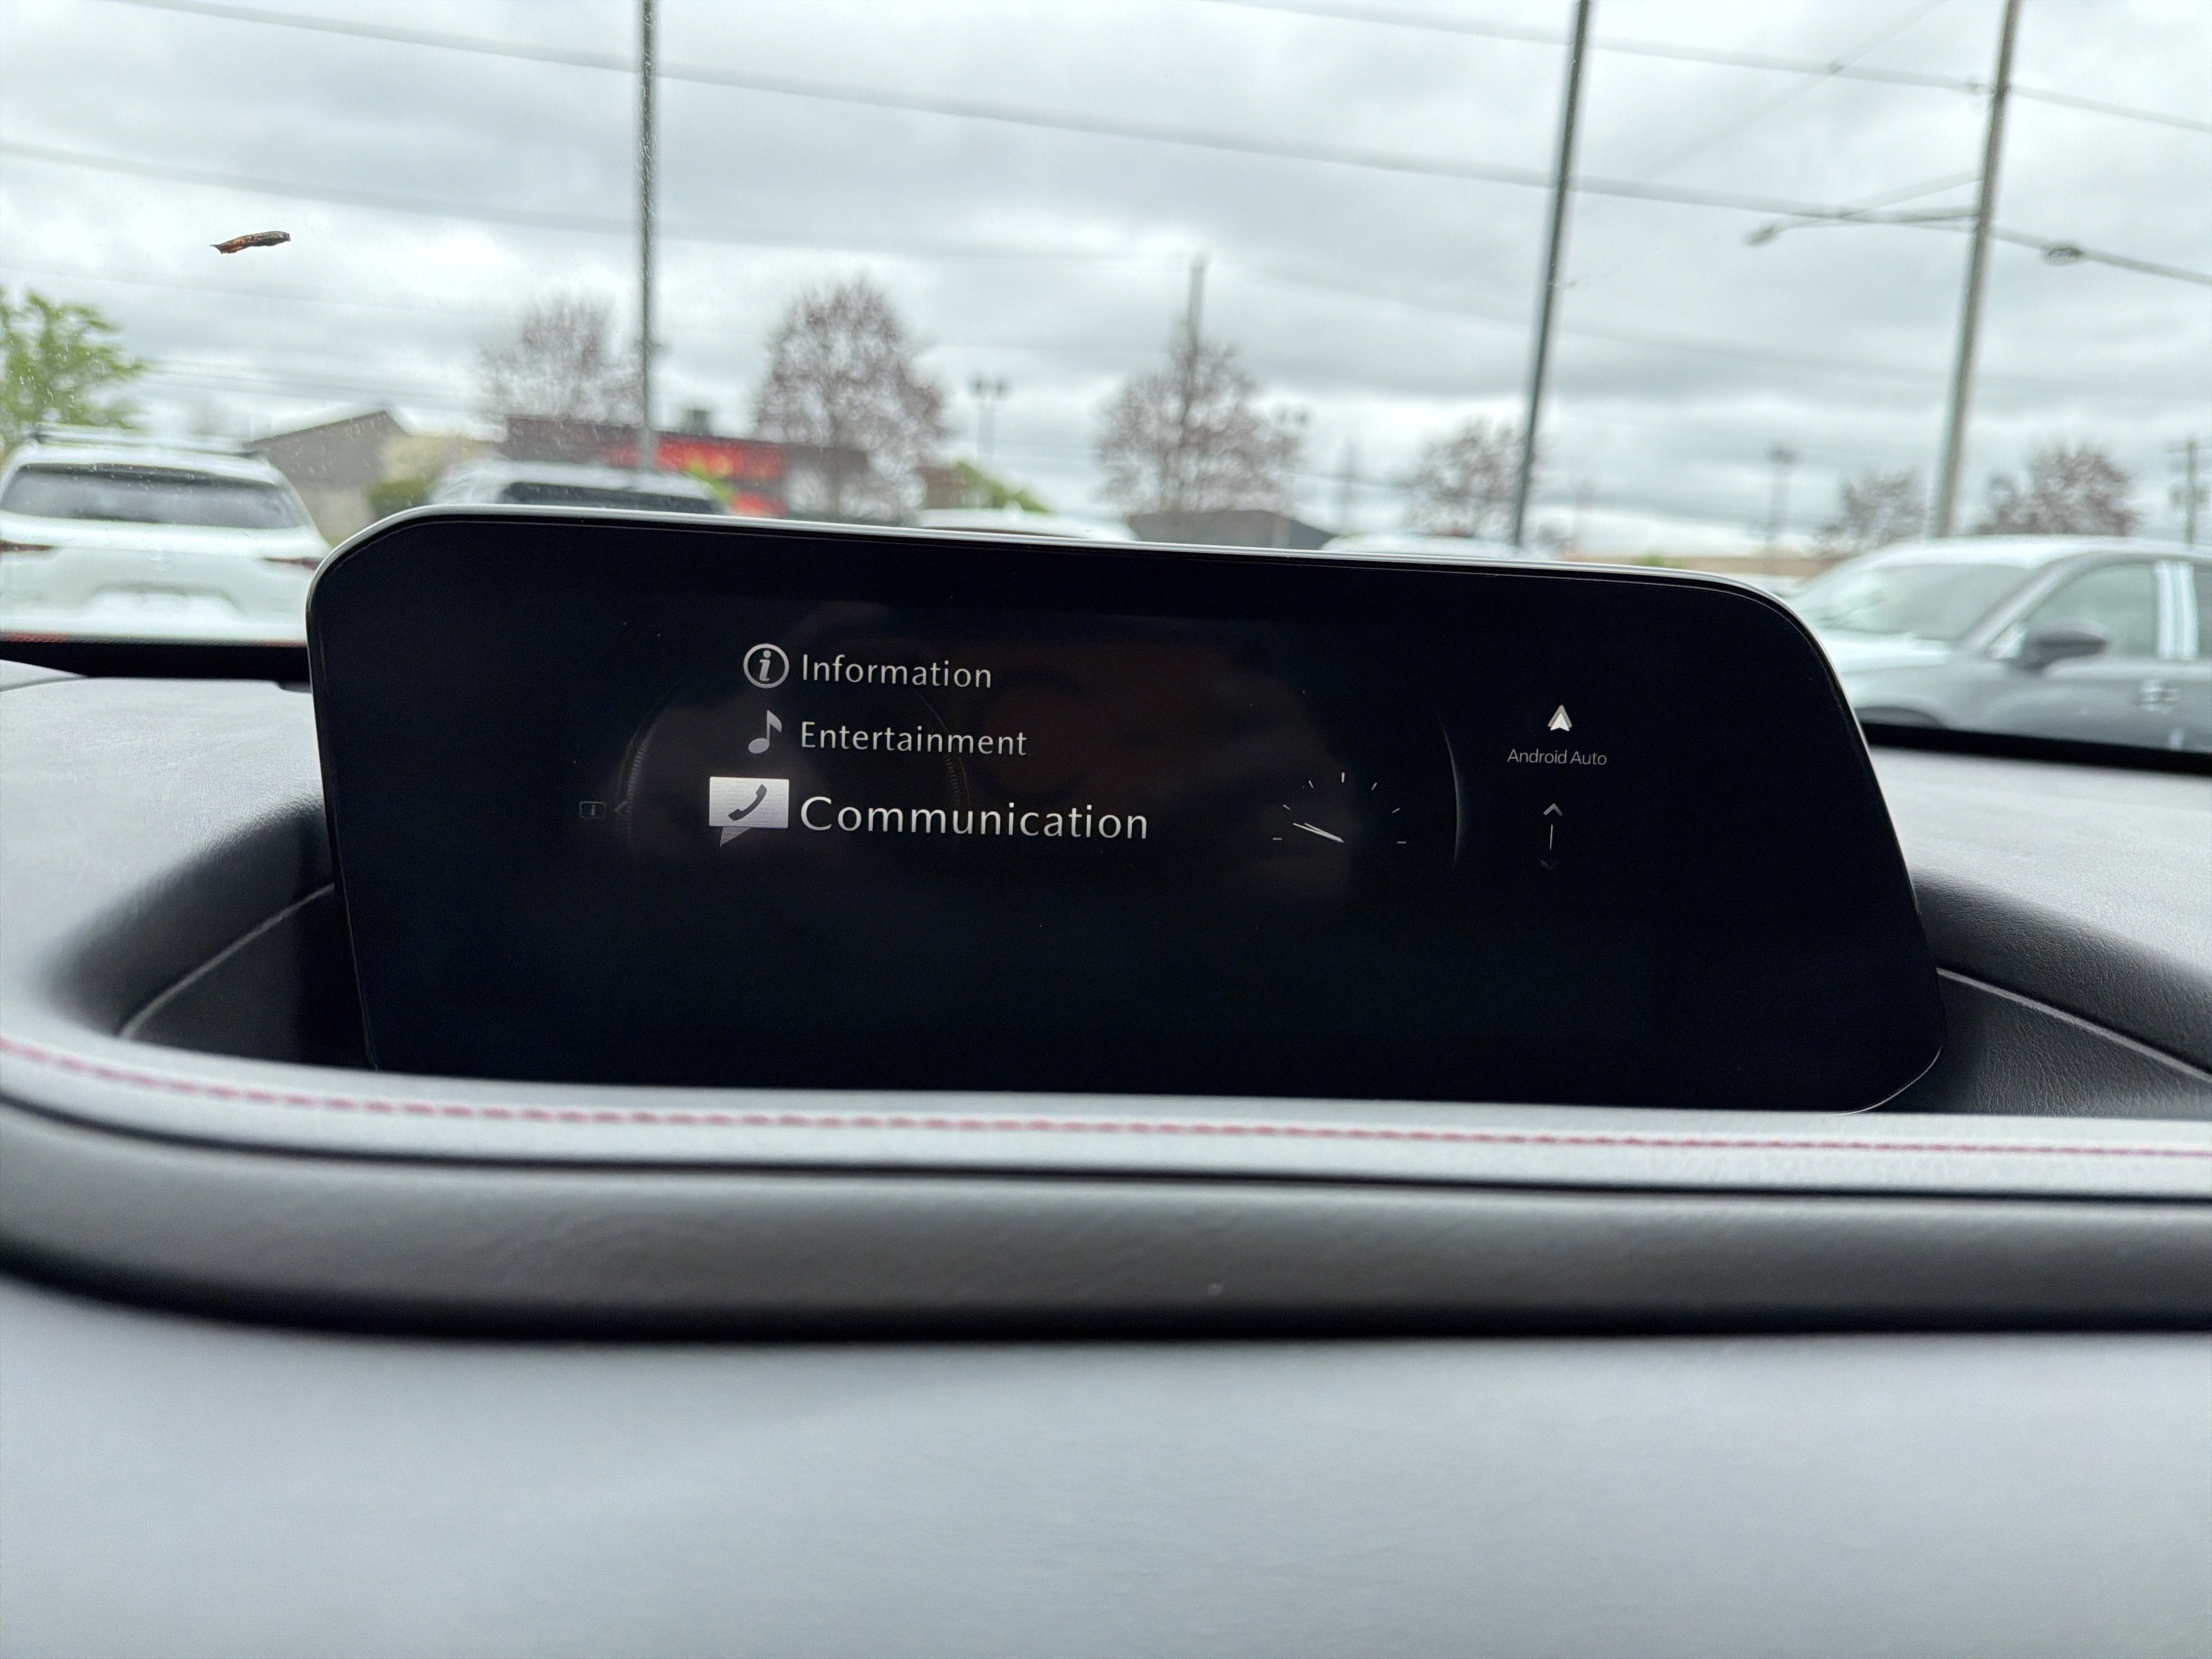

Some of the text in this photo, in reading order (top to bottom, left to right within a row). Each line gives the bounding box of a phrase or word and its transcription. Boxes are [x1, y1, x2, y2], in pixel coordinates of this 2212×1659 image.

[802, 653, 991, 689] Information
[801, 721, 1027, 756] Entertainment
[1507, 748, 1607, 765] Android Auto
[800, 796, 1148, 839] Communication
